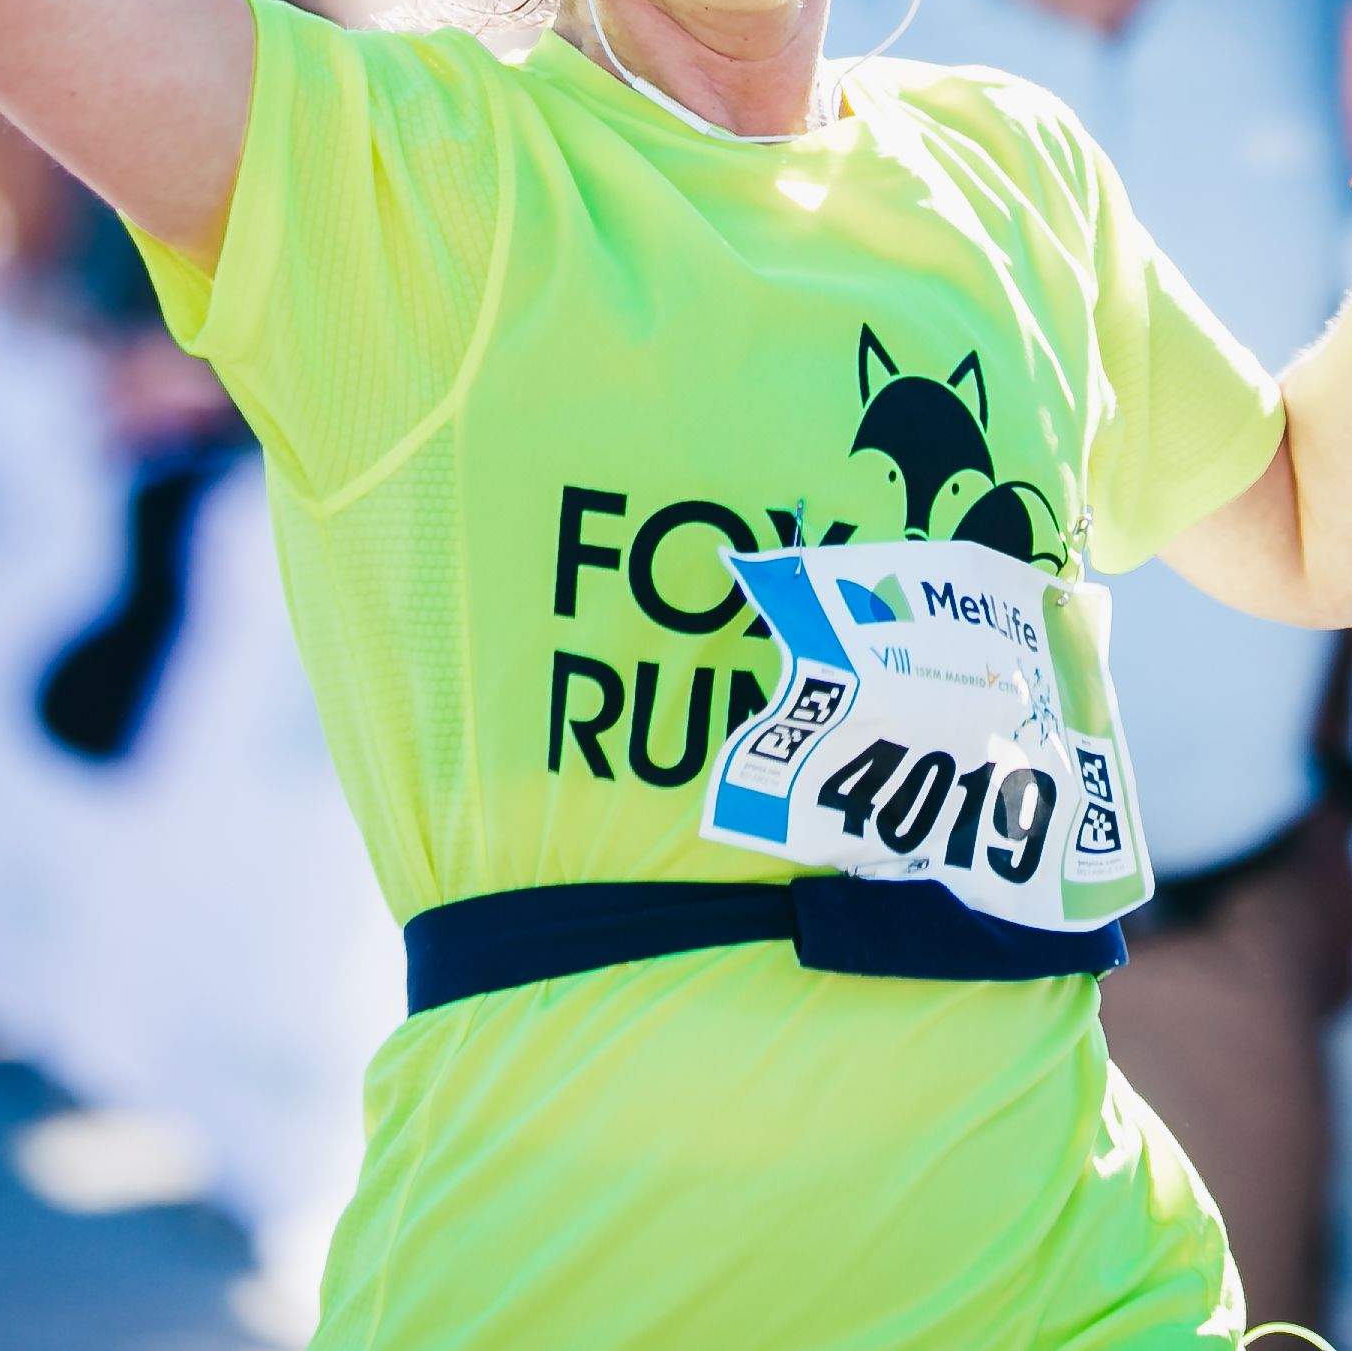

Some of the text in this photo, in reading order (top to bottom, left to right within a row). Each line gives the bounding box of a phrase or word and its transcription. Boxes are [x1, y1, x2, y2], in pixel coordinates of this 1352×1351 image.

[920, 581, 1038, 652] MetLife
[870, 645, 911, 676] VIII
[945, 671, 986, 689] MADRID
[817, 738, 1057, 884] 4019
